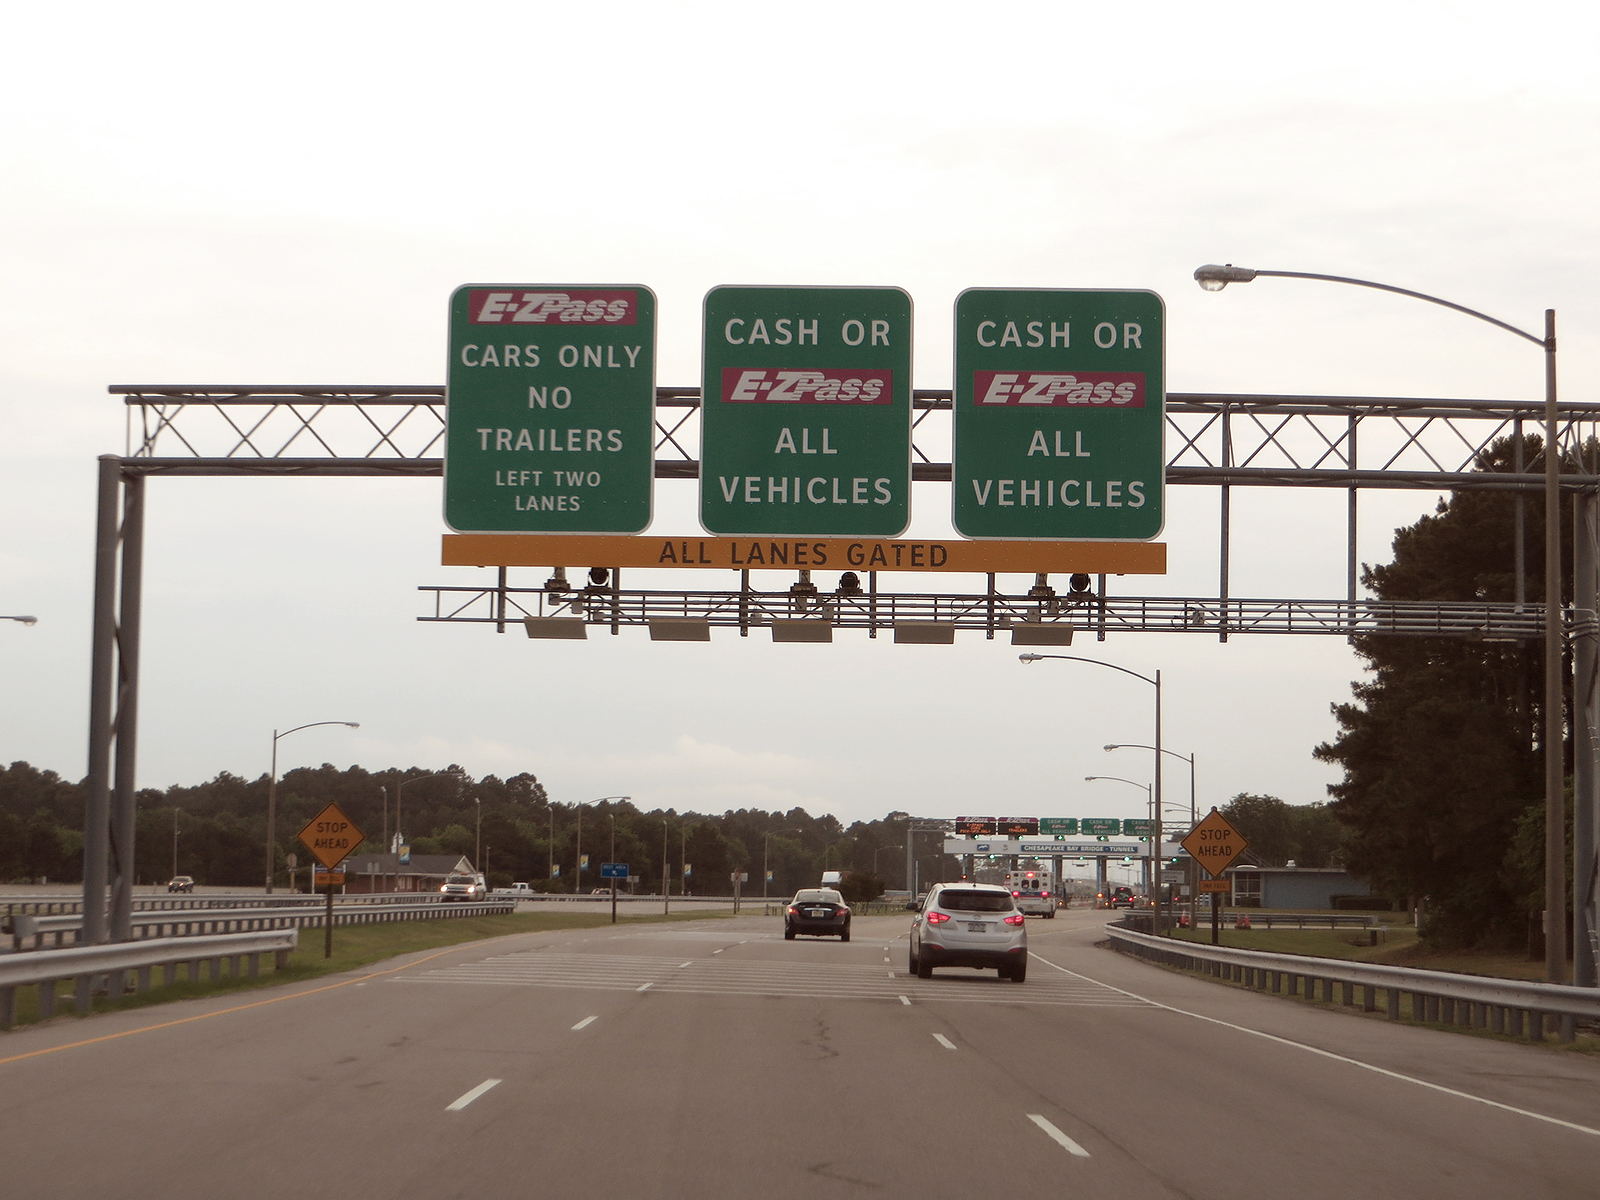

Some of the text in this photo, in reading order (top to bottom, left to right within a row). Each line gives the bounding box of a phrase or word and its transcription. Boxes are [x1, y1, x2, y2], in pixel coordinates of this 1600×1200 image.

[478, 293, 628, 322] E-ZPass
[725, 319, 890, 346] CASH OR
[977, 321, 1142, 349] CASH OR
[461, 345, 641, 368] CARS ONLY
[529, 386, 572, 409] NO
[730, 371, 884, 401] E-ZPass
[983, 374, 1137, 404] E-ZPass
[477, 428, 623, 452] TRAILERS
[774, 428, 838, 454] ALL
[1027, 431, 1091, 457] ALL
[496, 470, 601, 487] LEFT TWO
[719, 477, 892, 505] VEHICLES
[515, 495, 580, 511] LANES
[973, 479, 1145, 507] VEHICLES
[658, 541, 948, 568] ALL LANES GATED
[317, 822, 348, 832] STOP
[1200, 830, 1231, 840] STOP
[314, 838, 349, 849] AHEAD
[1198, 846, 1232, 856] AHEAD
